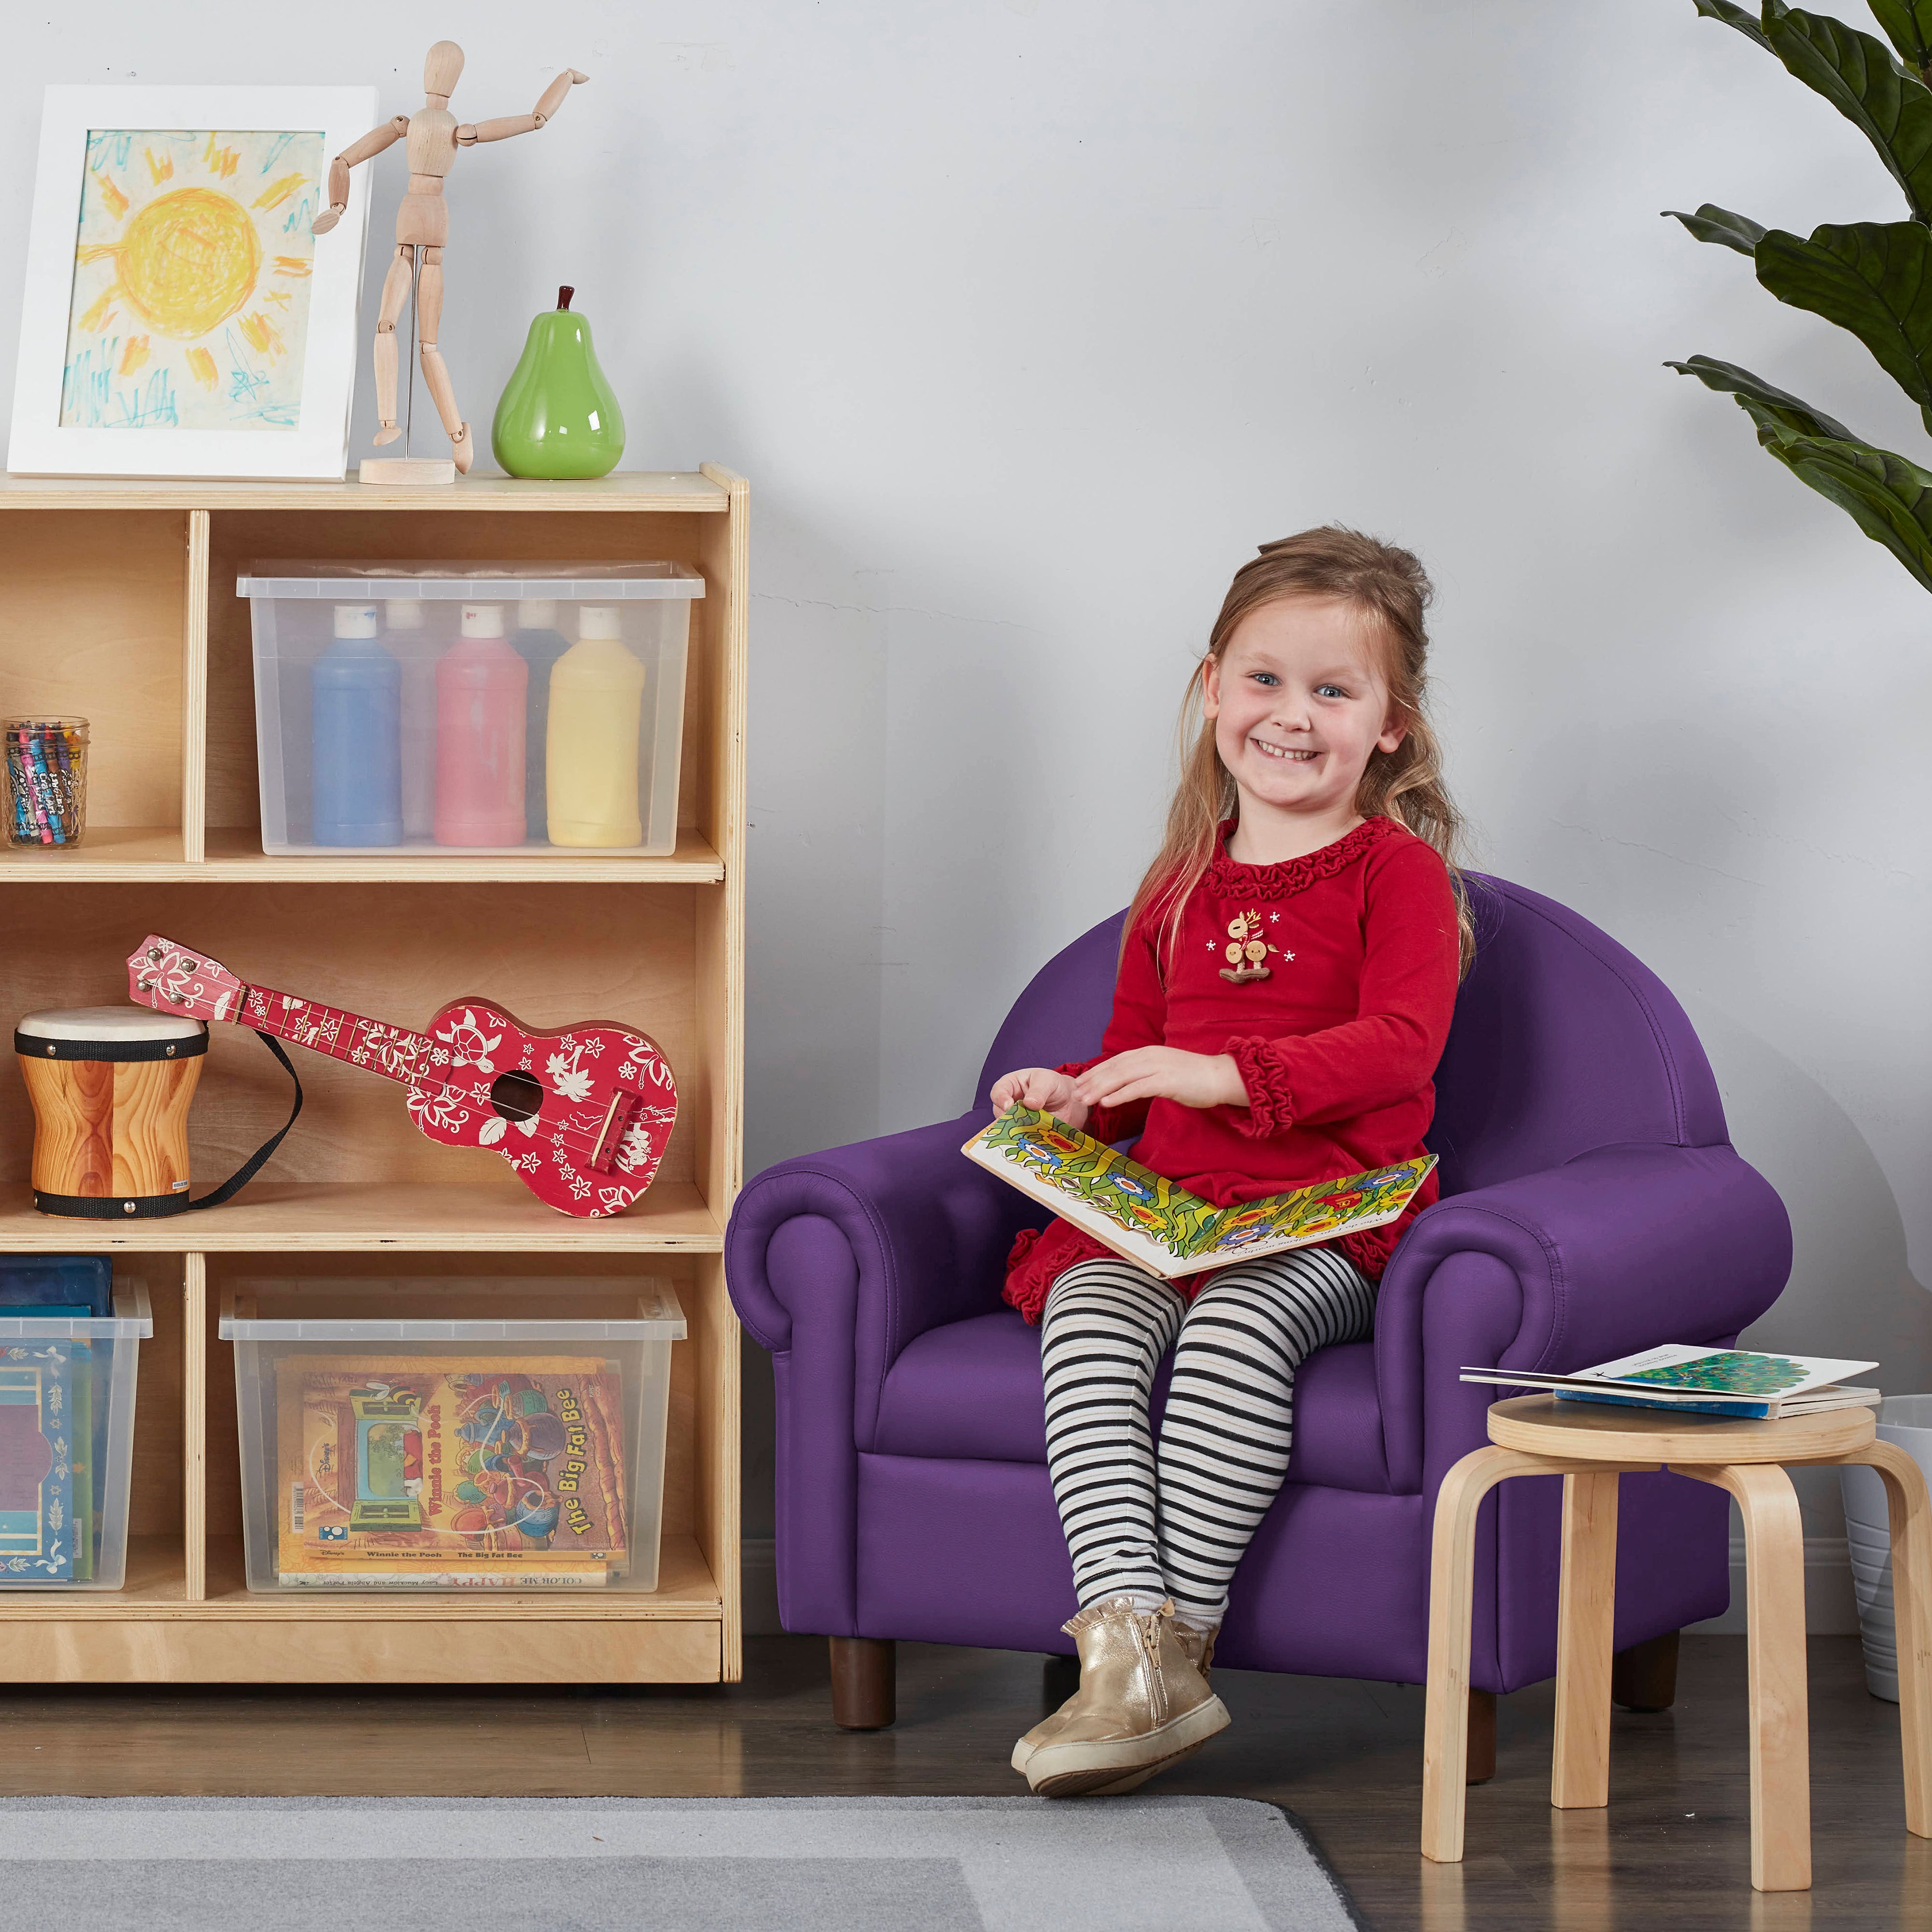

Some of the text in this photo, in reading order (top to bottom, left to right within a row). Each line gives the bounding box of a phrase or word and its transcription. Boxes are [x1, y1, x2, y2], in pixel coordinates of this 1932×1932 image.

[1279, 1234, 1315, 1246] walking
[319, 1443, 333, 1473] Disney's
[427, 1405, 442, 1516] Winnie the Pooh
[556, 1389, 594, 1535] The Big Fat Bee
[452, 1577, 516, 1587] HAPPY
